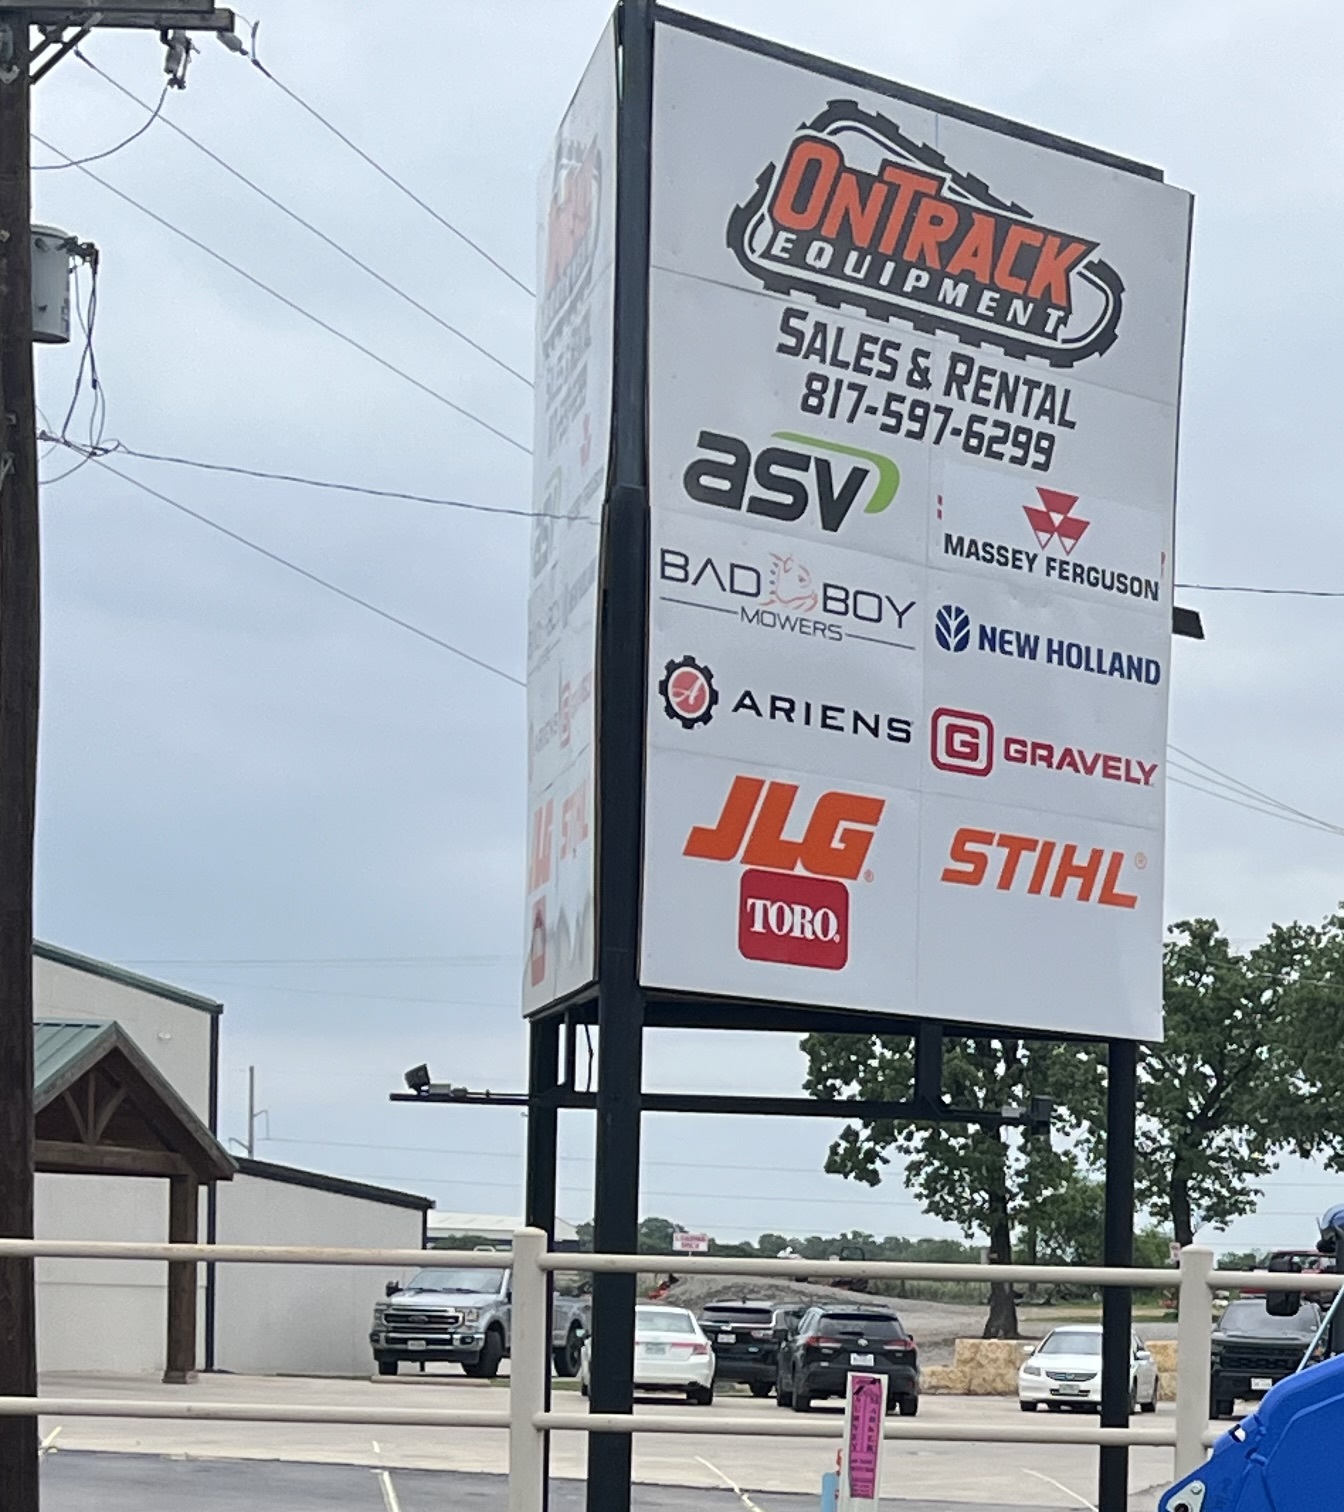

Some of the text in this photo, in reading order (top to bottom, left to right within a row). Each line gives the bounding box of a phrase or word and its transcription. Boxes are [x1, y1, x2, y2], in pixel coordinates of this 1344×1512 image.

[769, 231, 1069, 342] EQUIPMENT
[776, 308, 1078, 430] SALES & RENTAL
[800, 372, 1056, 471] 817-597-6299
[660, 547, 916, 628] BAD BOY
[943, 533, 1159, 601] MASSEY FERGUSON
[741, 605, 843, 642] MOWERS
[978, 624, 1160, 686] NEW HOLLAND
[732, 690, 912, 743] ARIENS
[1003, 736, 1158, 787] GRAVELY
[683, 776, 885, 879] JLG
[940, 827, 1139, 909] STIHL
[747, 899, 839, 940] TORO
